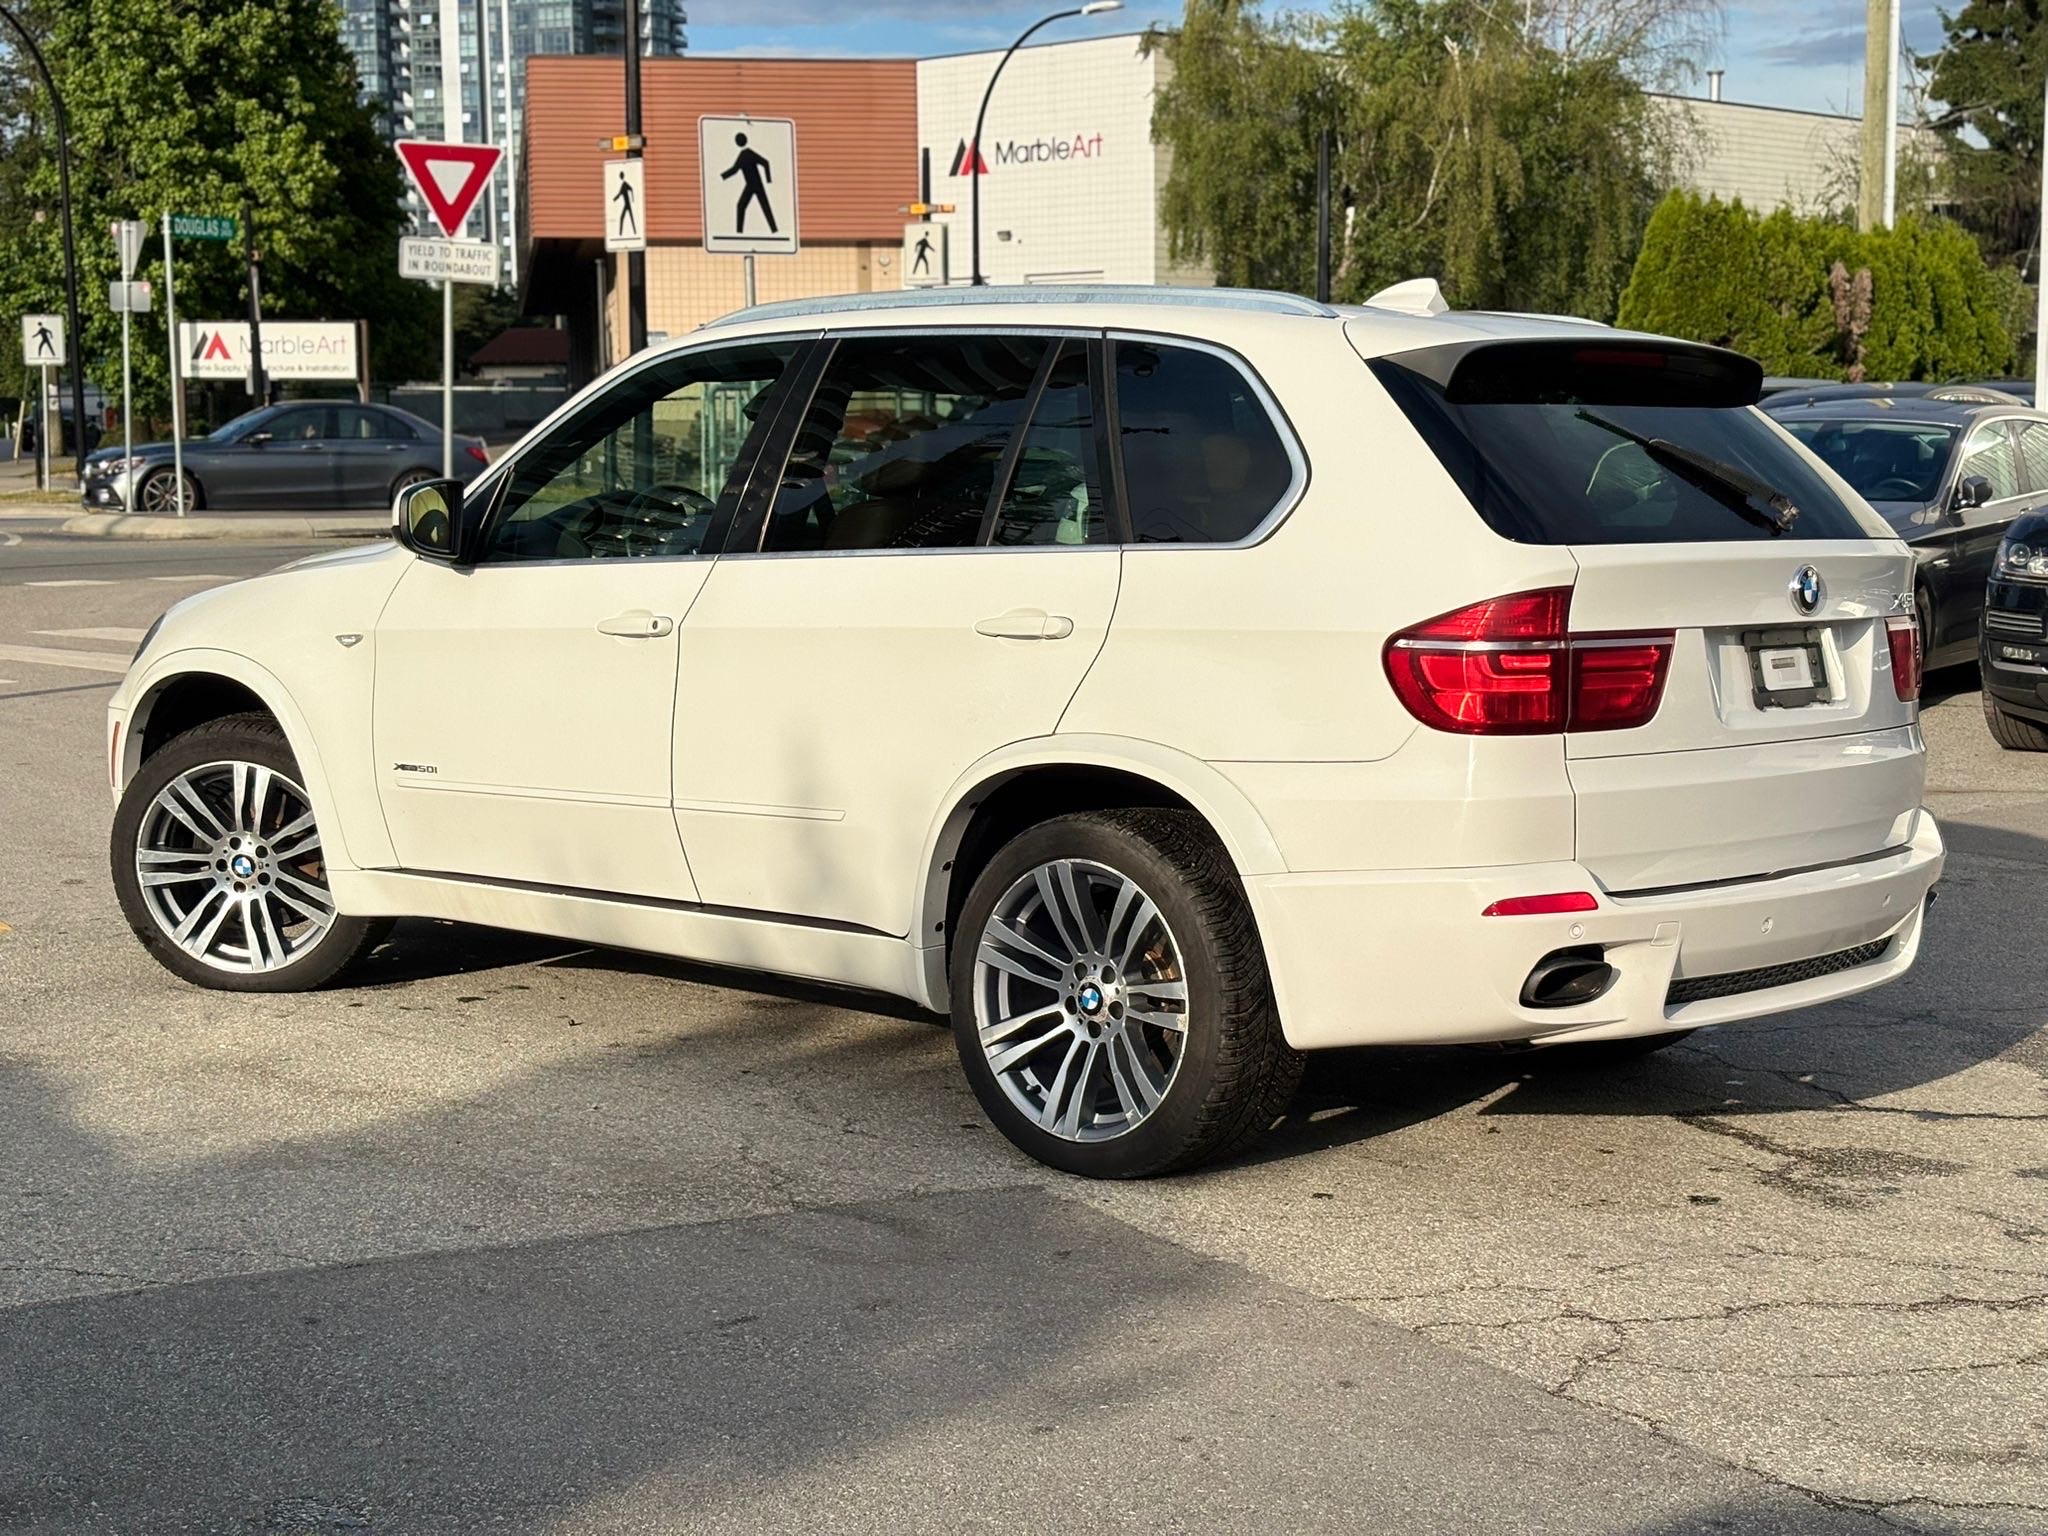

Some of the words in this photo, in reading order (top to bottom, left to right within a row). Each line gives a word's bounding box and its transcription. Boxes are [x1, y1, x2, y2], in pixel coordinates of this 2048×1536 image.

[995, 132, 1103, 165] MarbleArt
[174, 217, 219, 236] DOUGLAS
[408, 245, 435, 257] YIELD
[439, 246, 452, 258] TO
[455, 248, 493, 262] TRAFFIC
[408, 261, 419, 271] IN
[424, 261, 491, 277] ROUNDABOUT
